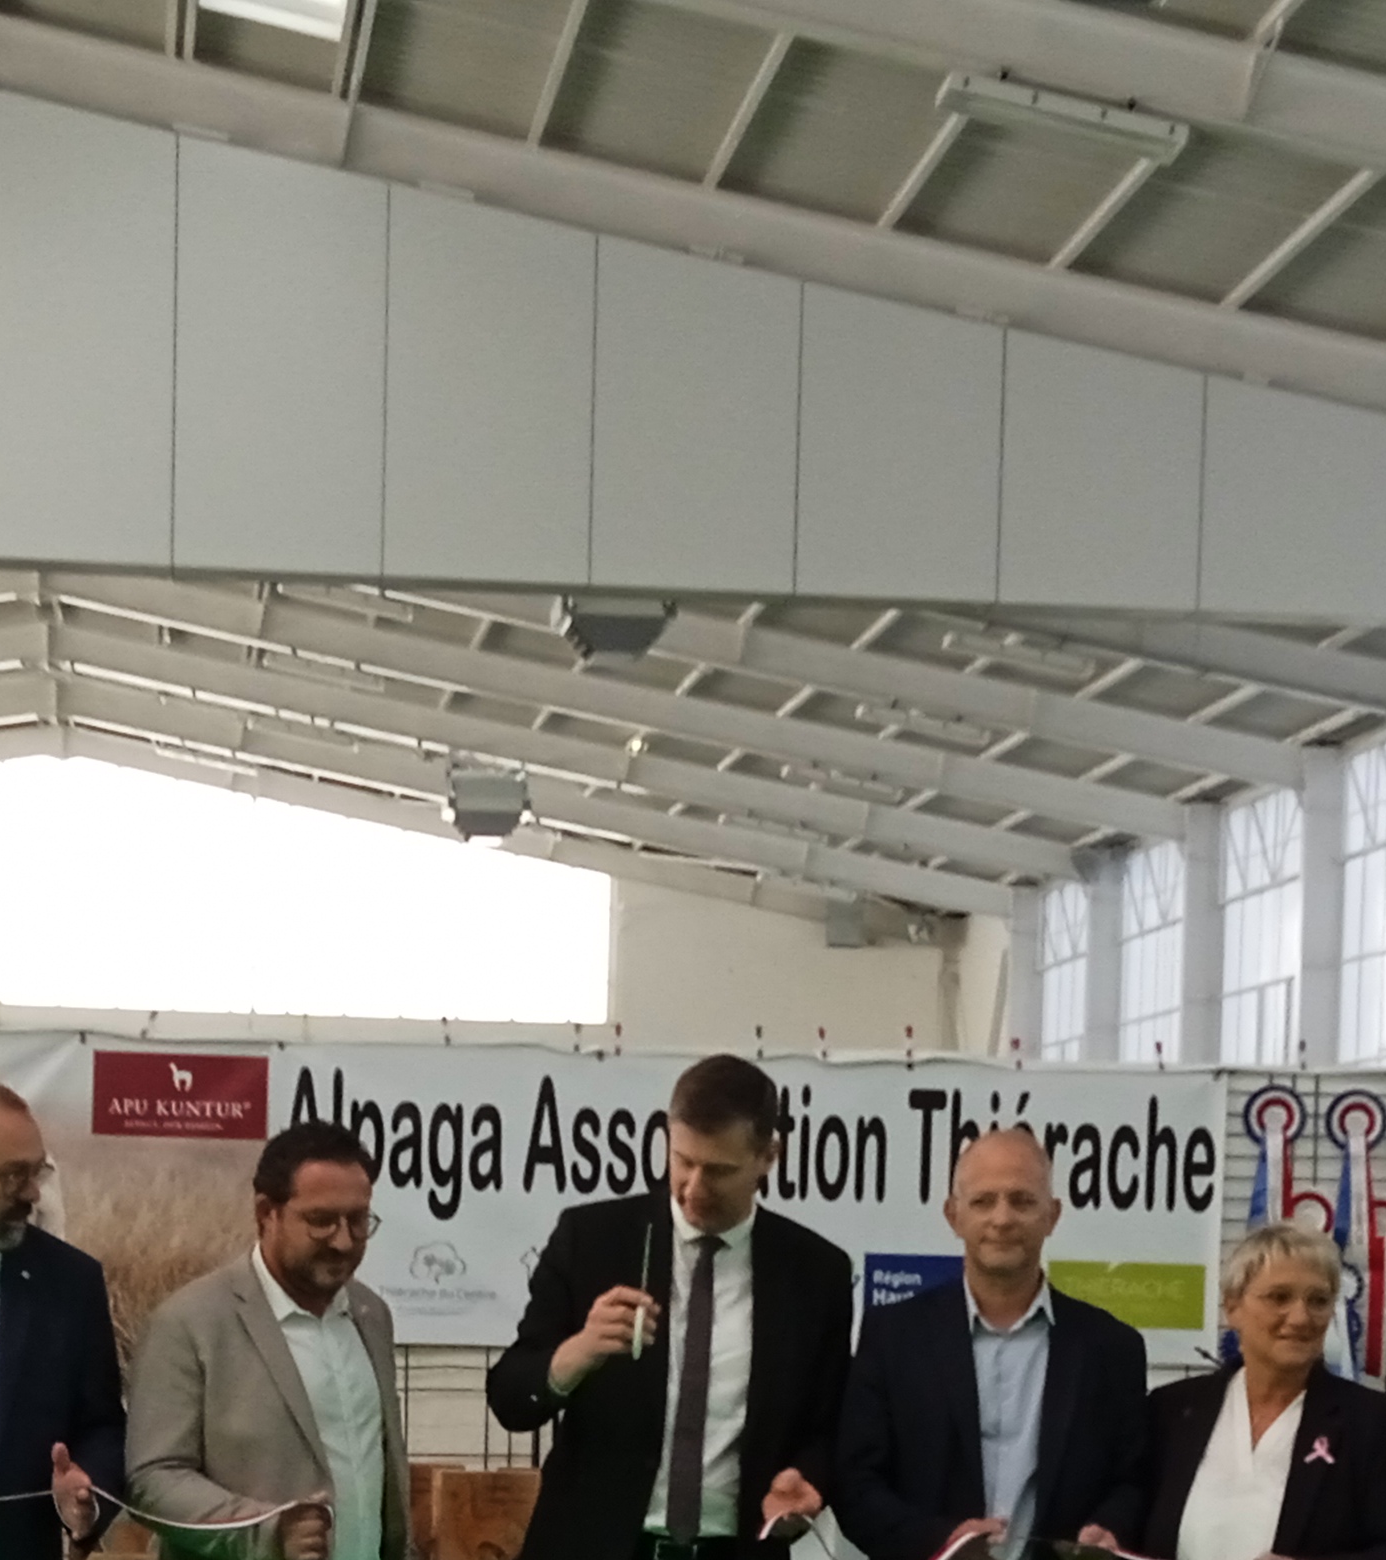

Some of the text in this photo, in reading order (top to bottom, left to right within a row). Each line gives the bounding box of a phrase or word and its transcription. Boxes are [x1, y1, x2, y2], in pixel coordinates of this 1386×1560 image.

[109, 1098, 149, 1116] APU
[523, 1075, 887, 1204] Assotion
[873, 1269, 922, 1289] Région
